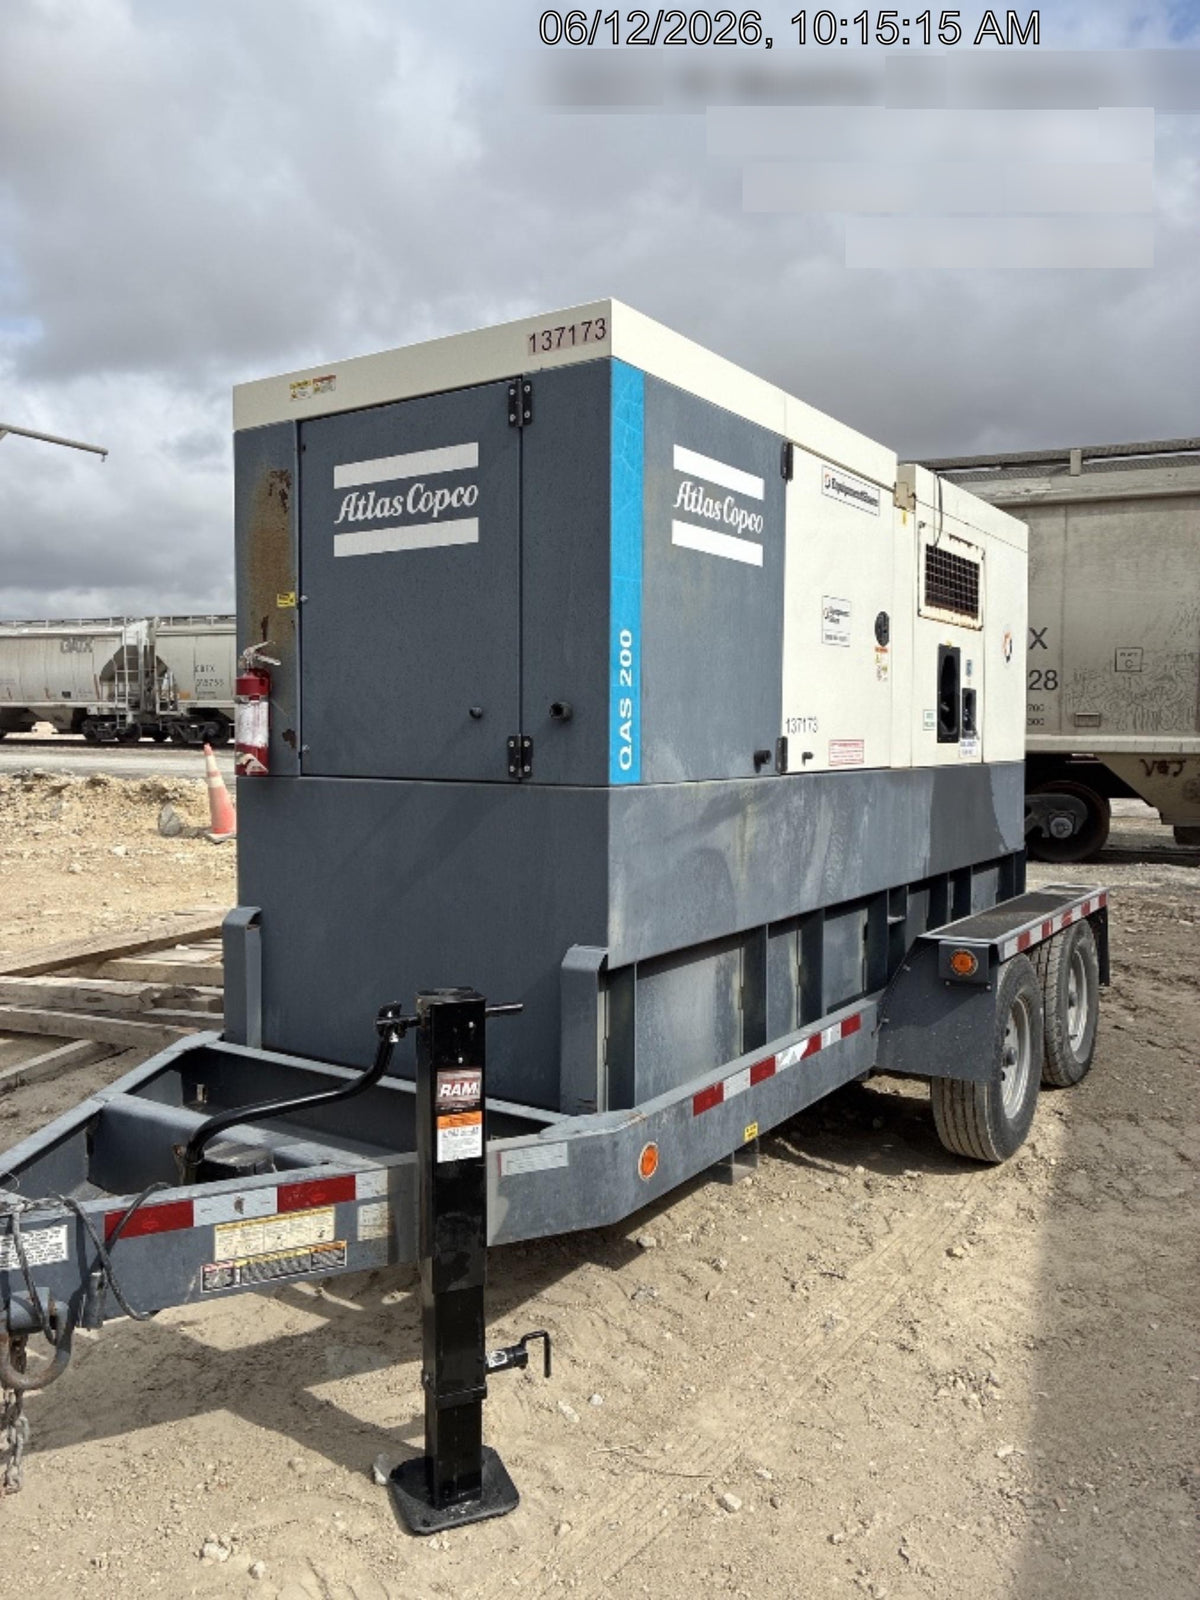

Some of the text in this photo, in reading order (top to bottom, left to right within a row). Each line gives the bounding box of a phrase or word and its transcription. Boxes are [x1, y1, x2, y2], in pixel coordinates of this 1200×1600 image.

[529, 317, 607, 353] 137173
[333, 483, 479, 524] Atlas Copco
[672, 480, 764, 534] Atlas Copco
[1028, 669, 1059, 691] 28
[618, 628, 633, 771] QAS 200
[786, 715, 818, 734] 137173
[440, 1082, 478, 1098] RAM
